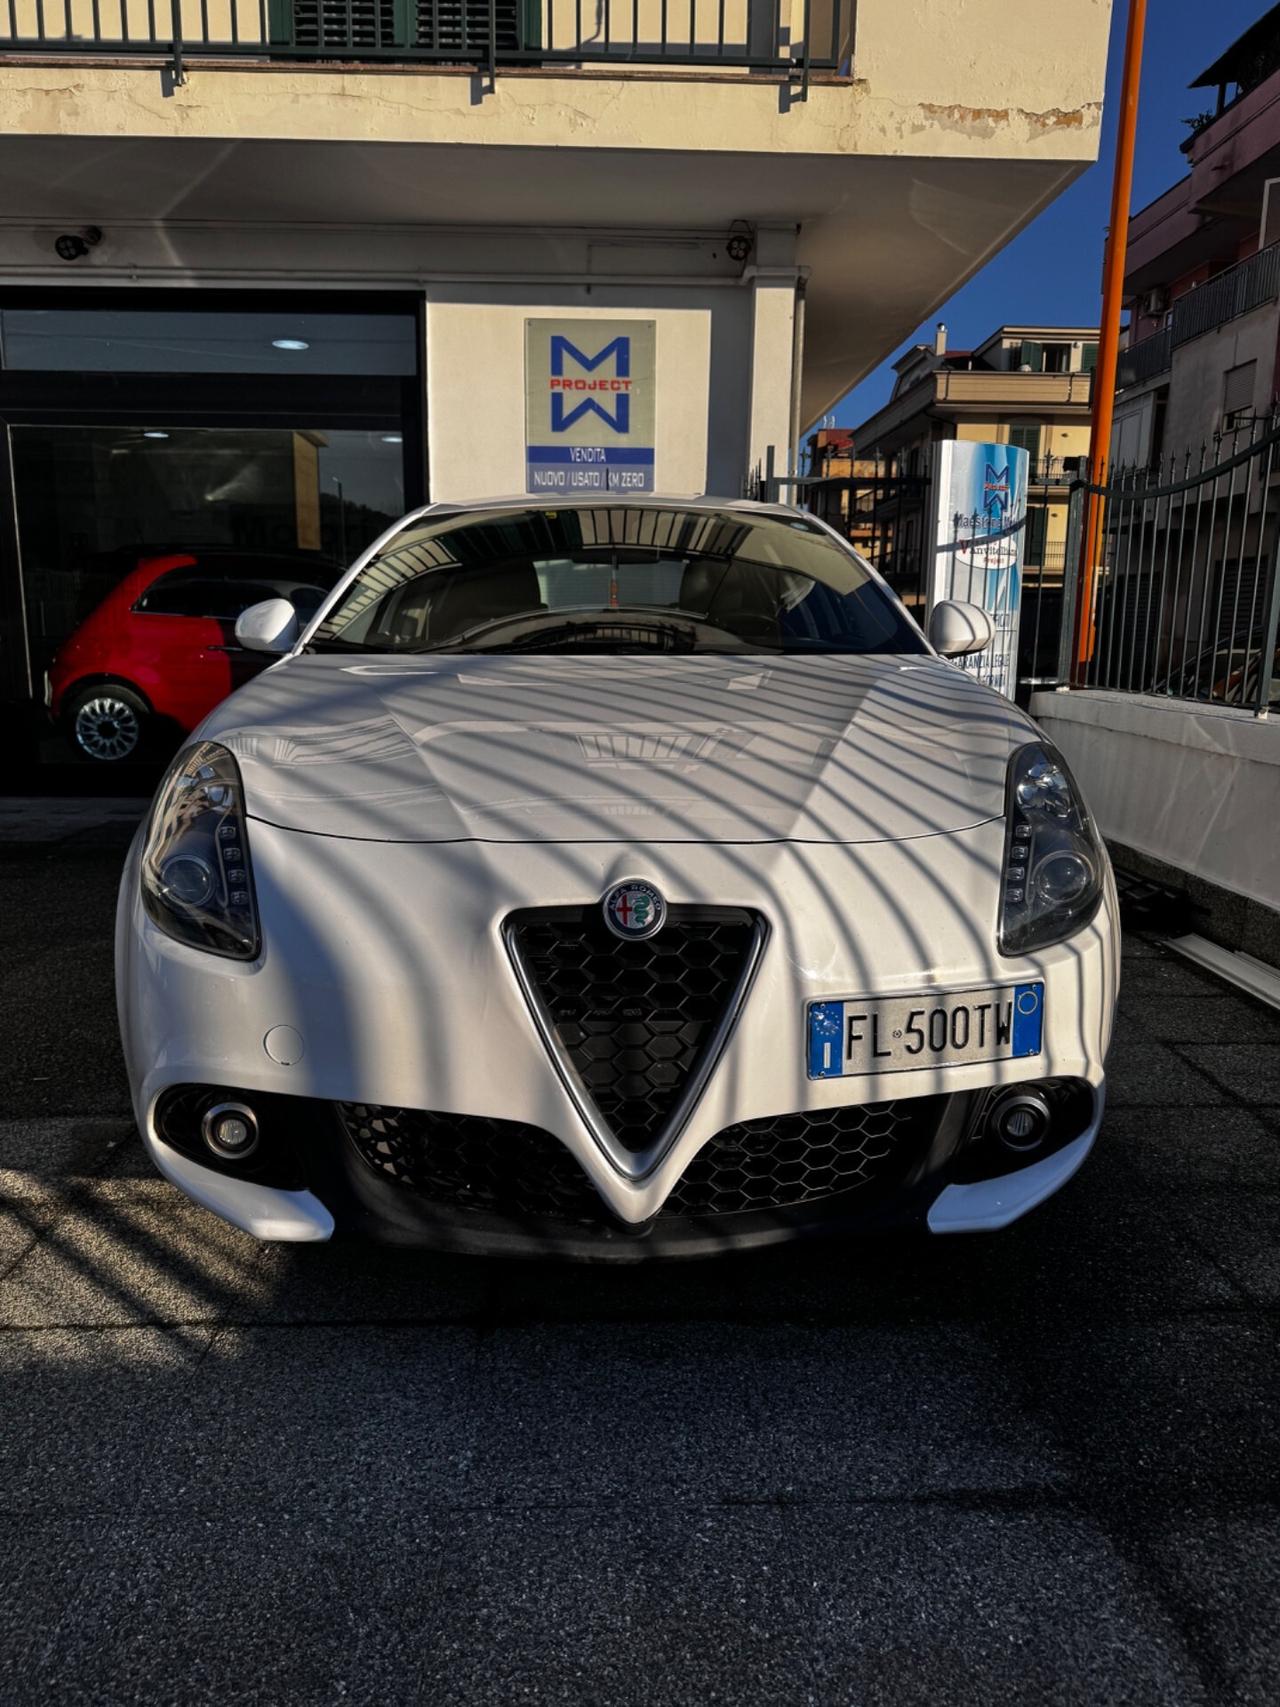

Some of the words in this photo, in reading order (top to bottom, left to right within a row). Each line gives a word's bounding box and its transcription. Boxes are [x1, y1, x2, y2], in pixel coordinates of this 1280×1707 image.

[549, 379, 633, 391] PROJECT
[569, 447, 607, 463] VENDITA
[534, 471, 565, 486] NUOVO
[571, 472, 600, 487] USATO
[621, 472, 645, 488] ZERO
[608, 888, 628, 911] ALFA
[630, 884, 661, 911] ROMEO
[846, 1013, 892, 1060] FL
[905, 1000, 1014, 1055] 500TW
